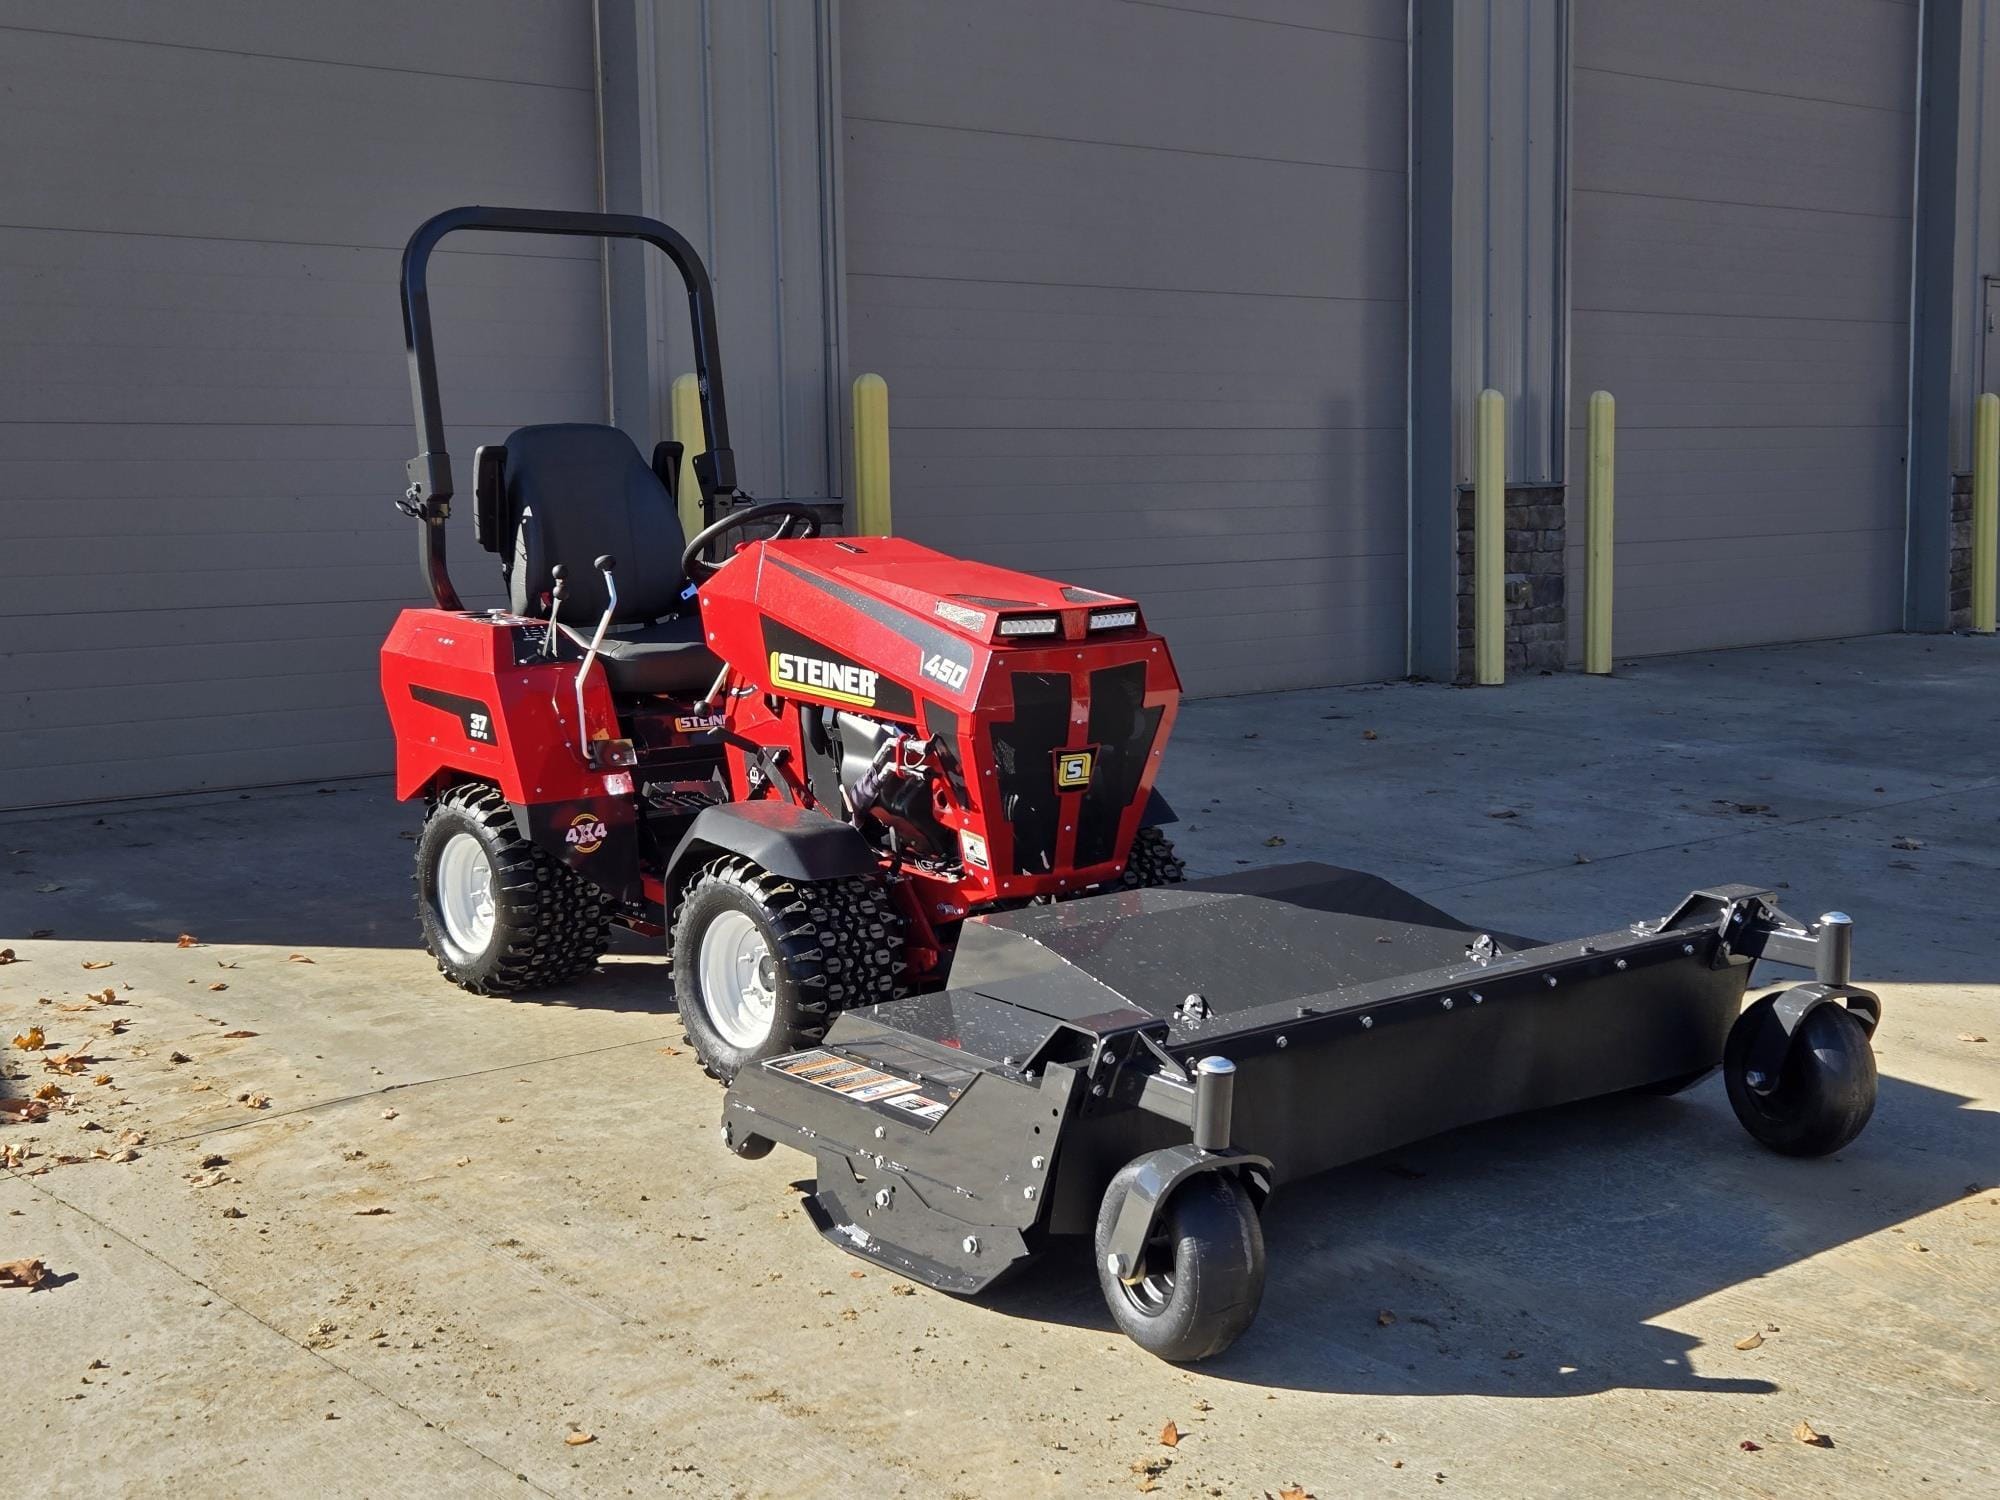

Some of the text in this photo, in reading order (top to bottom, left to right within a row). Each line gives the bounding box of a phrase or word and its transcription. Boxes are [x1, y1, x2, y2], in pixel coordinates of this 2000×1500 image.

[778, 652, 876, 698] STEINER
[923, 654, 969, 689] 450
[470, 712, 488, 731] 37
[1066, 760, 1083, 779] S
[565, 822, 608, 844] 4X4
